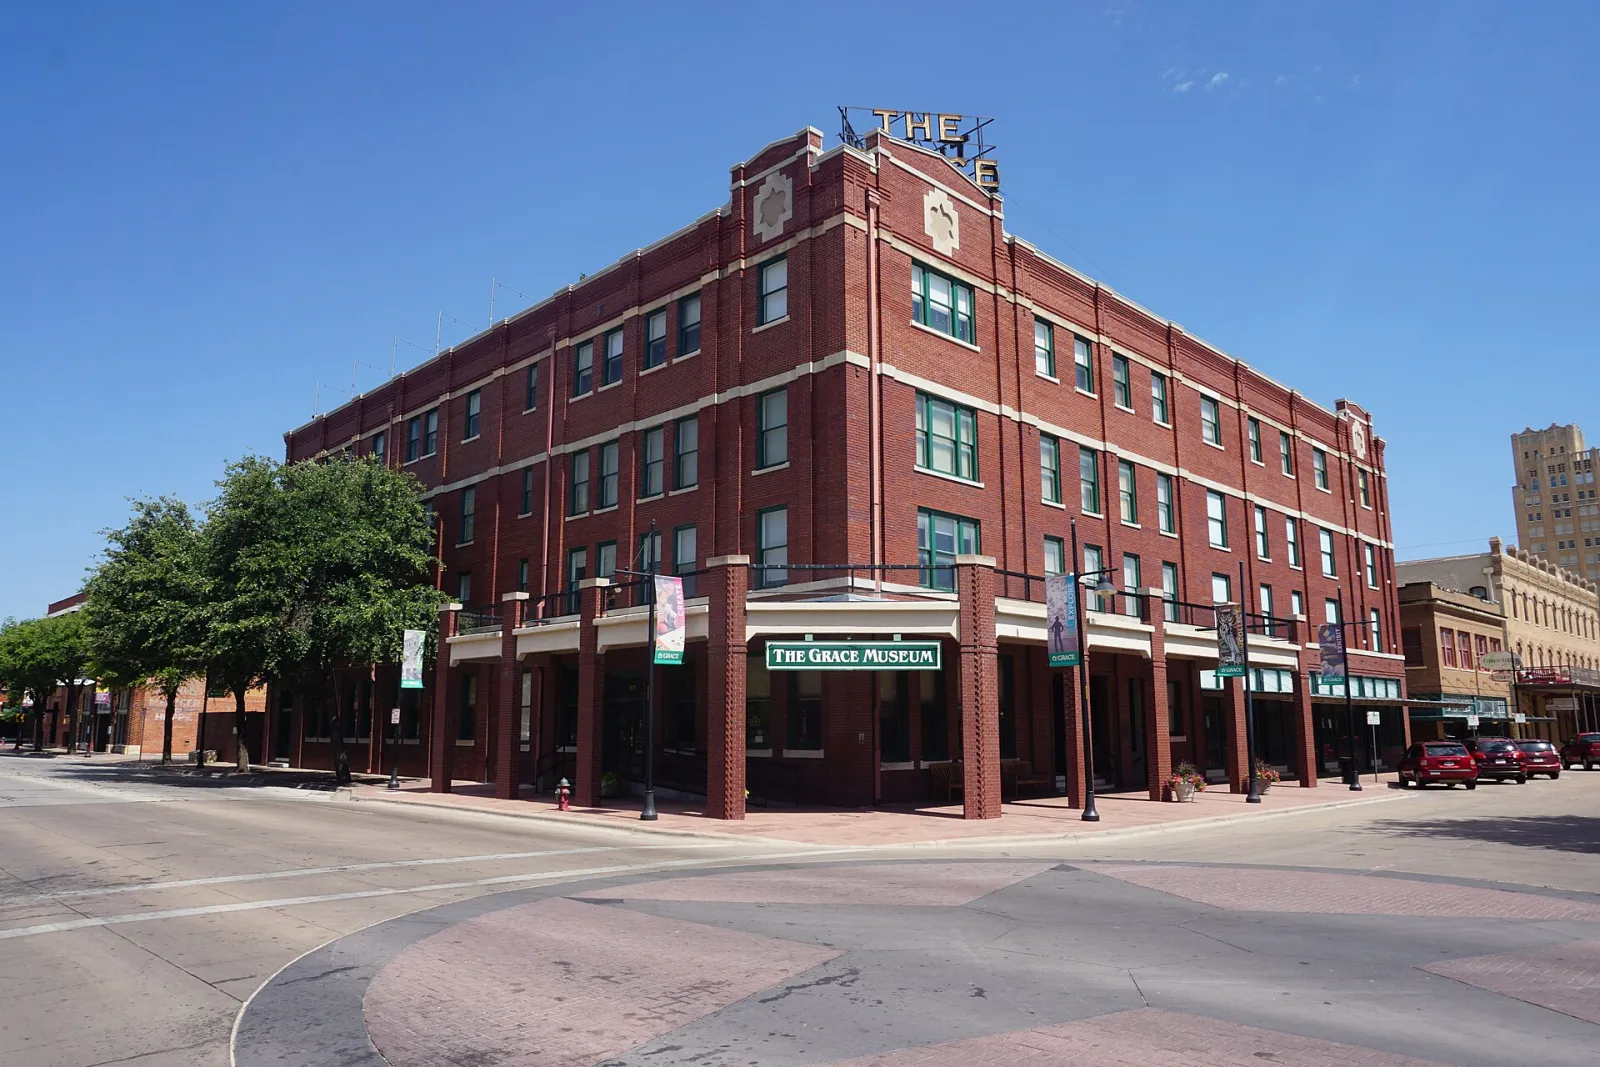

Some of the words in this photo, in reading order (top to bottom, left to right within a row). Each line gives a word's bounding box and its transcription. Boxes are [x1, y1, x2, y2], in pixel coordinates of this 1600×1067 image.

[872, 109, 963, 142] THE
[675, 584, 684, 616] CREATE
[1067, 583, 1075, 620] EXPLORE
[772, 648, 806, 663] THE
[1335, 628, 1343, 654] EXHIBIT
